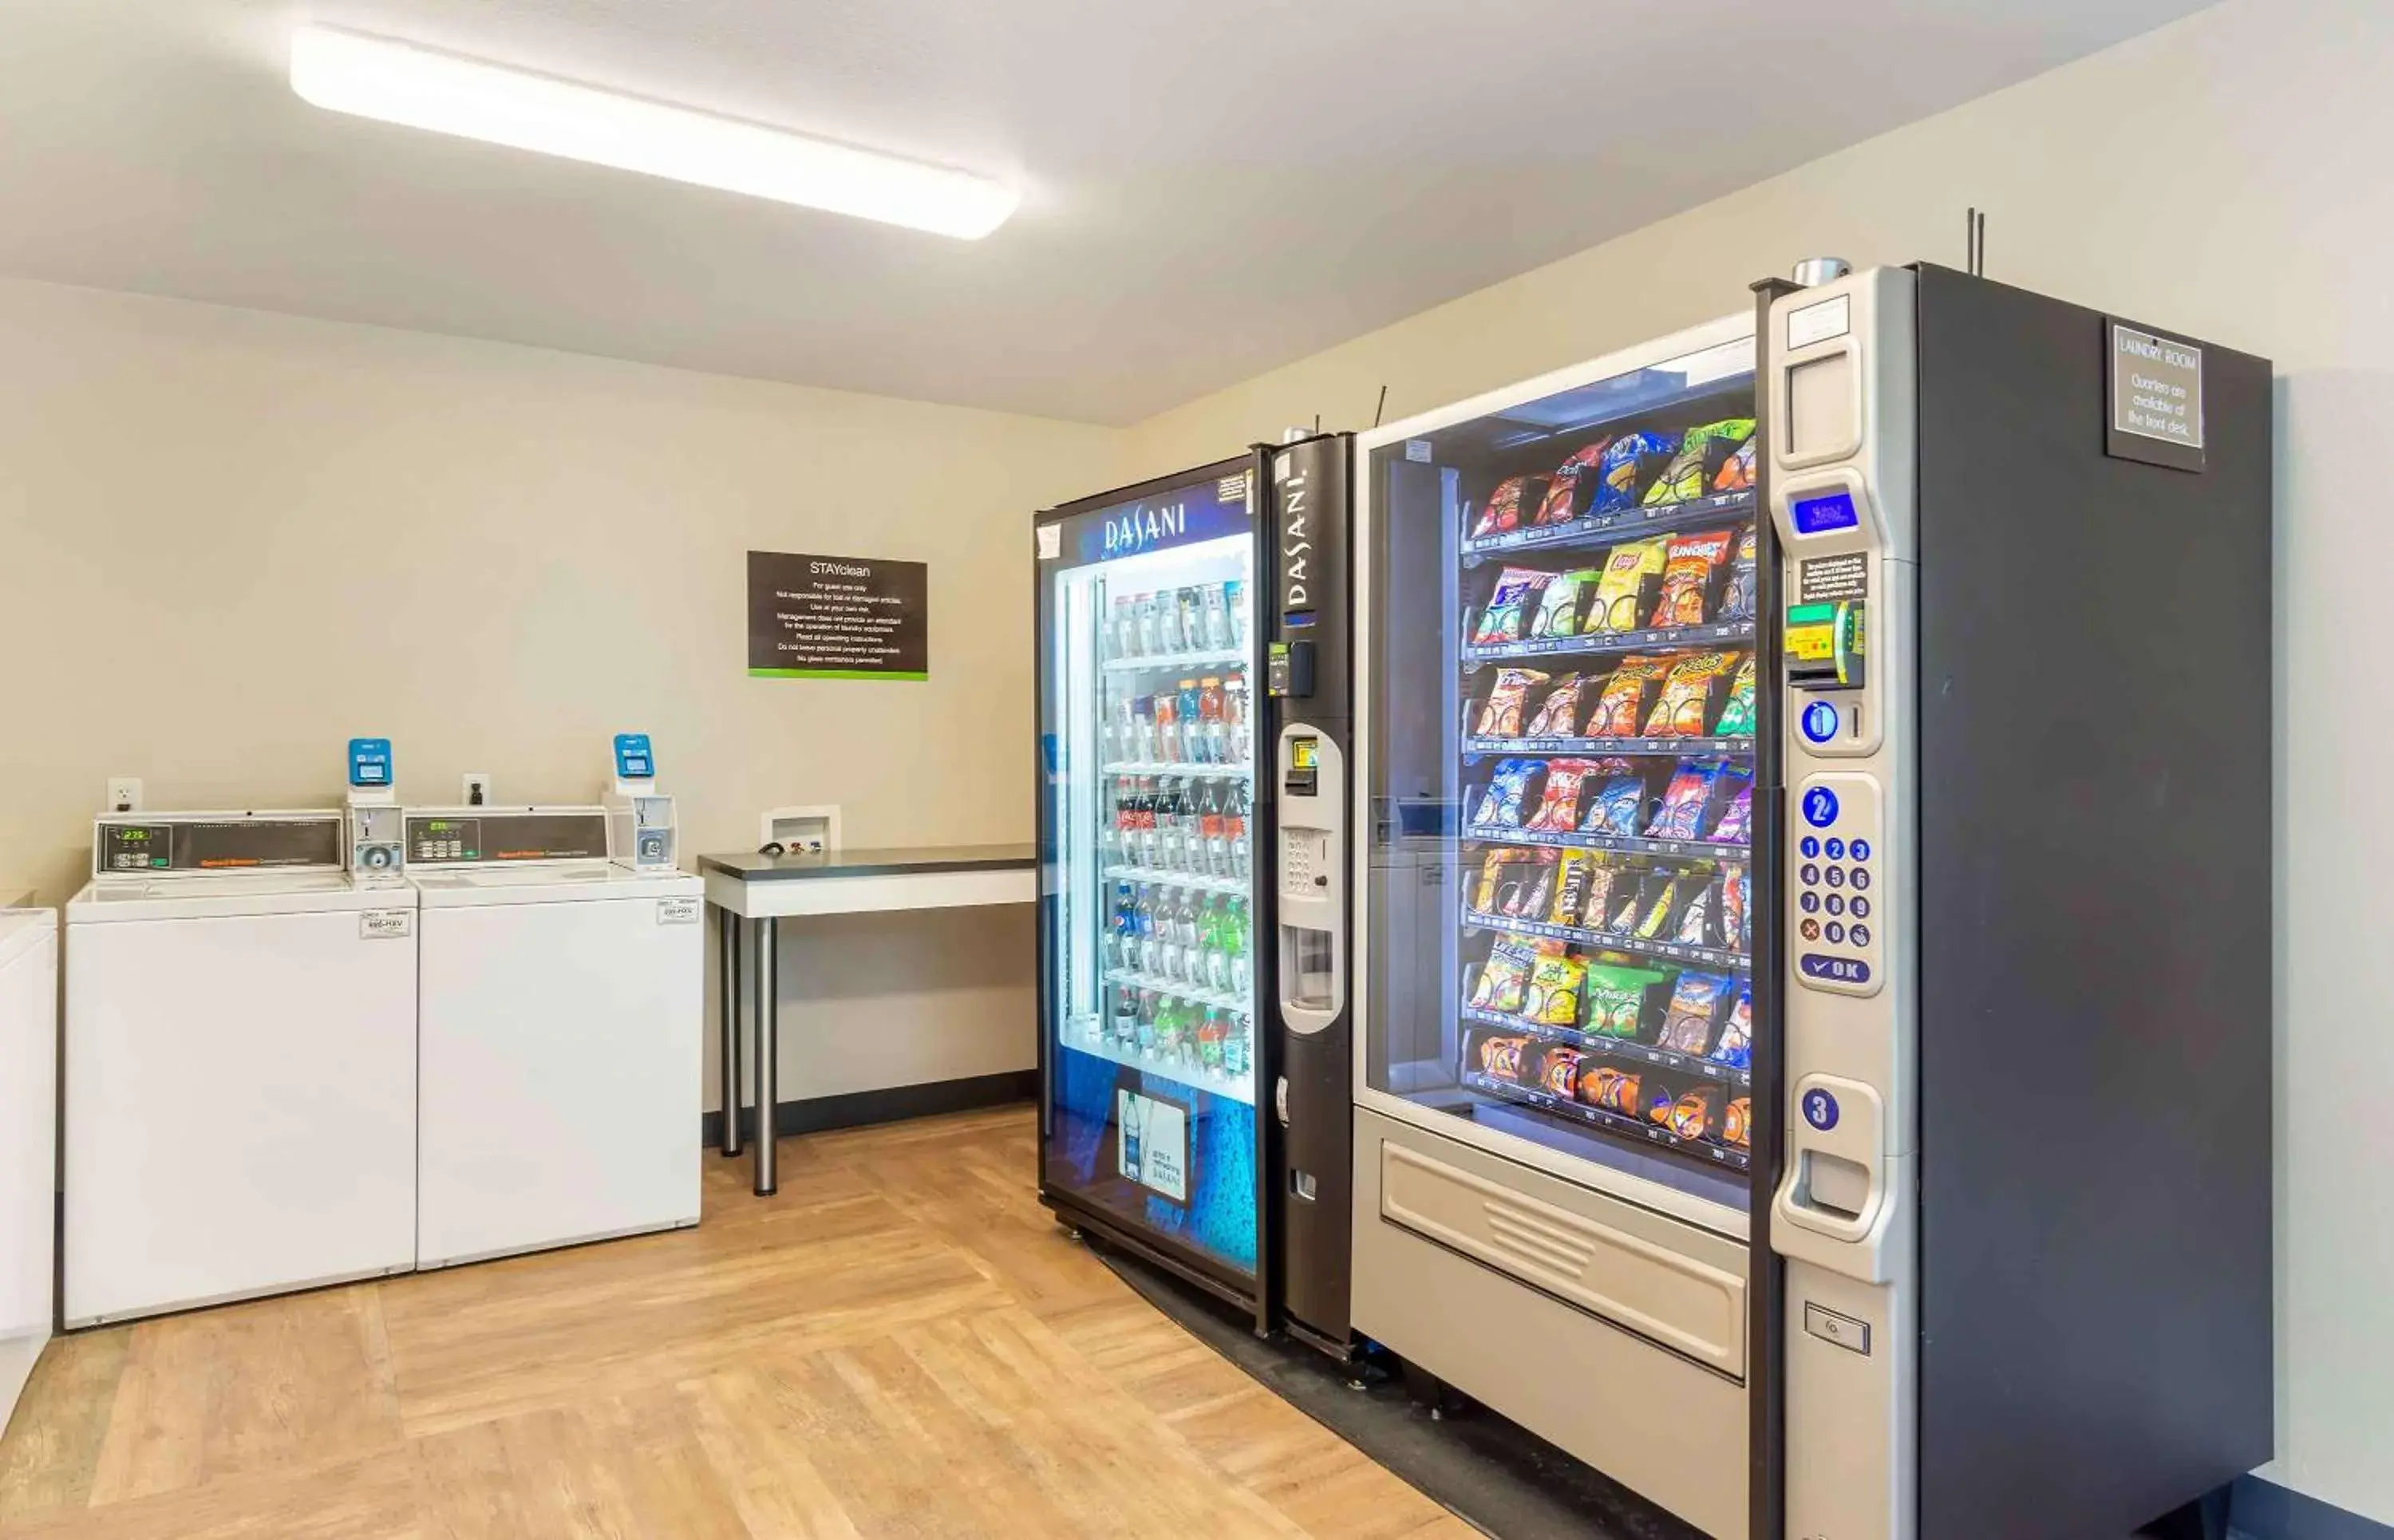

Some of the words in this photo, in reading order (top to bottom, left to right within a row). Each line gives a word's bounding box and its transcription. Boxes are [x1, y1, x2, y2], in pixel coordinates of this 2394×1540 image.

[2165, 349, 2196, 369] ROOM
[2127, 409, 2143, 426] the
[2145, 413, 2166, 431] front
[1105, 503, 1185, 551] DASANI
[1284, 479, 1312, 606] DASANI
[810, 561, 871, 578] STAYclean
[776, 613, 816, 622] Management
[1813, 709, 1823, 735] 1
[1812, 794, 1827, 821] 2
[1807, 841, 1814, 856] 1
[1831, 842, 1839, 858] 2
[1855, 843, 1866, 859] 3
[1806, 867, 1815, 883] 4
[1831, 871, 1840, 886] 5
[1856, 872, 1866, 887] 6
[1807, 895, 1815, 910] 7
[1831, 898, 1840, 913] 8
[1857, 900, 1867, 916] 9
[1831, 926, 1840, 941] 0
[1832, 962, 1859, 978] OK
[1812, 1096, 1827, 1125] 3
